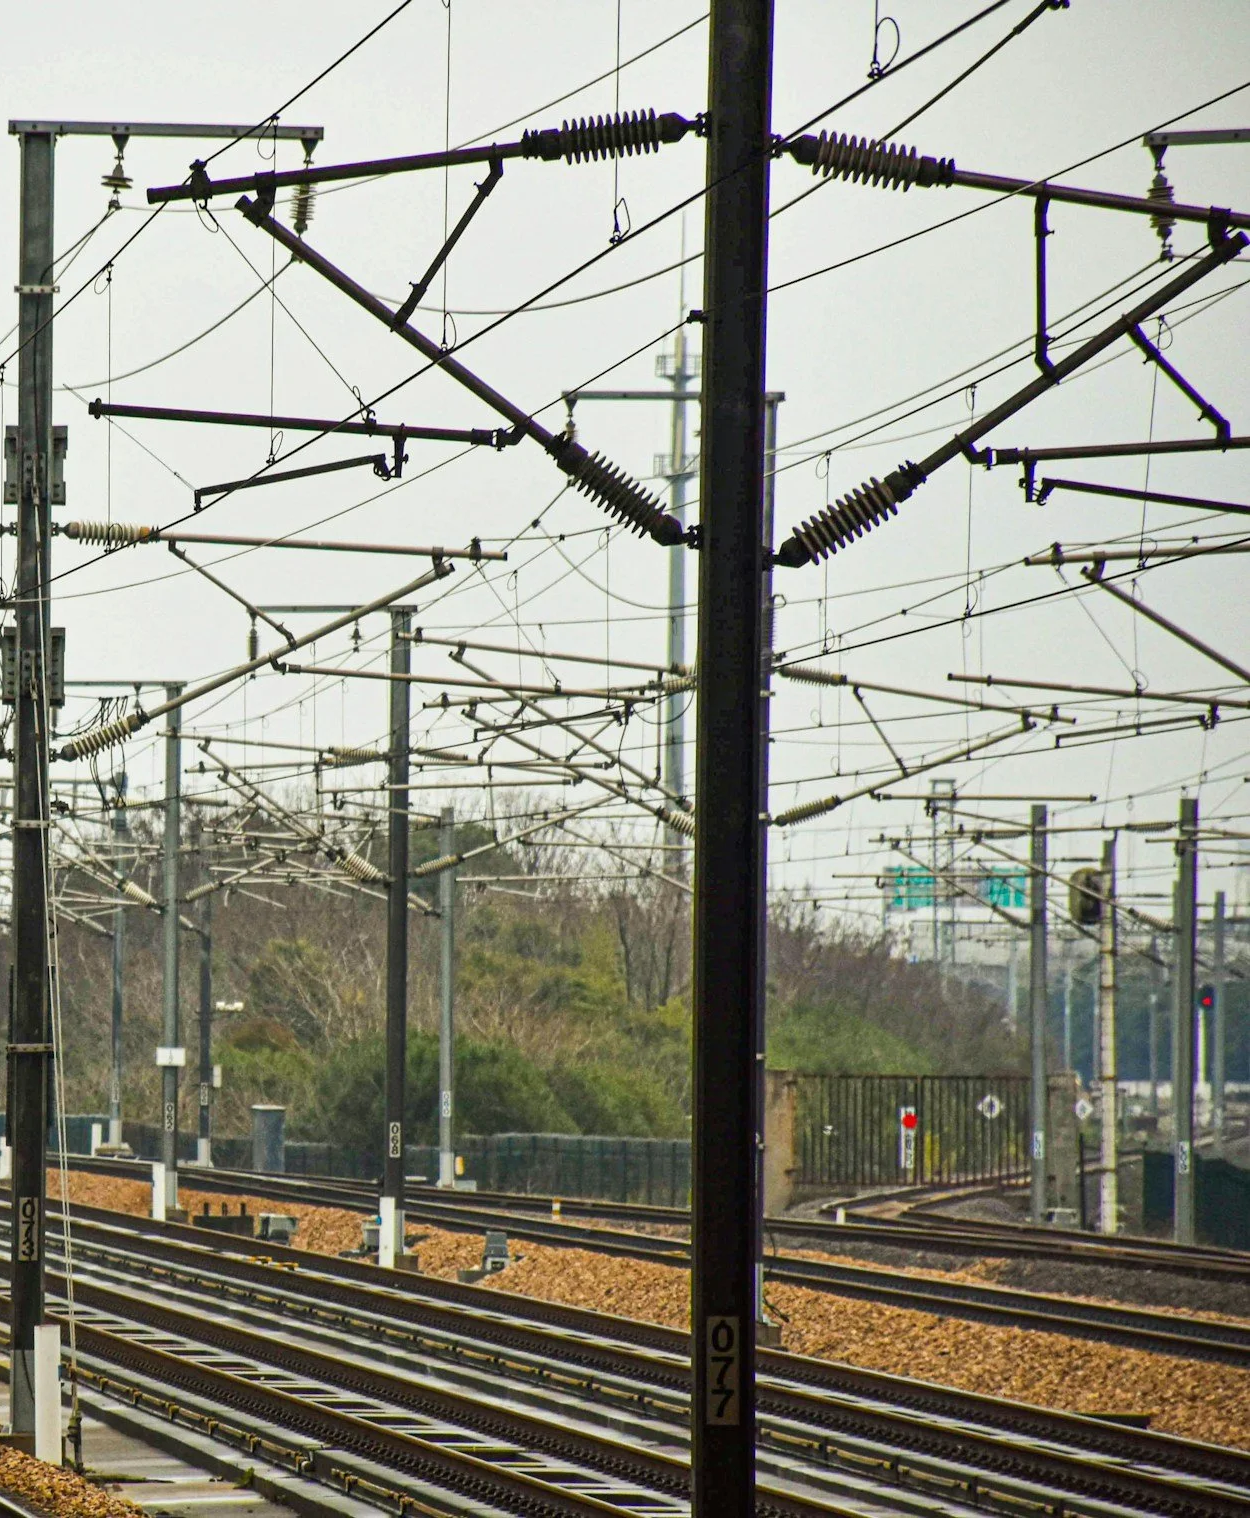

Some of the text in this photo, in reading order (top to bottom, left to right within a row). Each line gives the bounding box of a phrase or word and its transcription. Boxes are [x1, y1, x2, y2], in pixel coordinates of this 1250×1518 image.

[391, 1123, 399, 1155] 068
[22, 1200, 35, 1257] 073
[711, 1320, 734, 1418] 077
